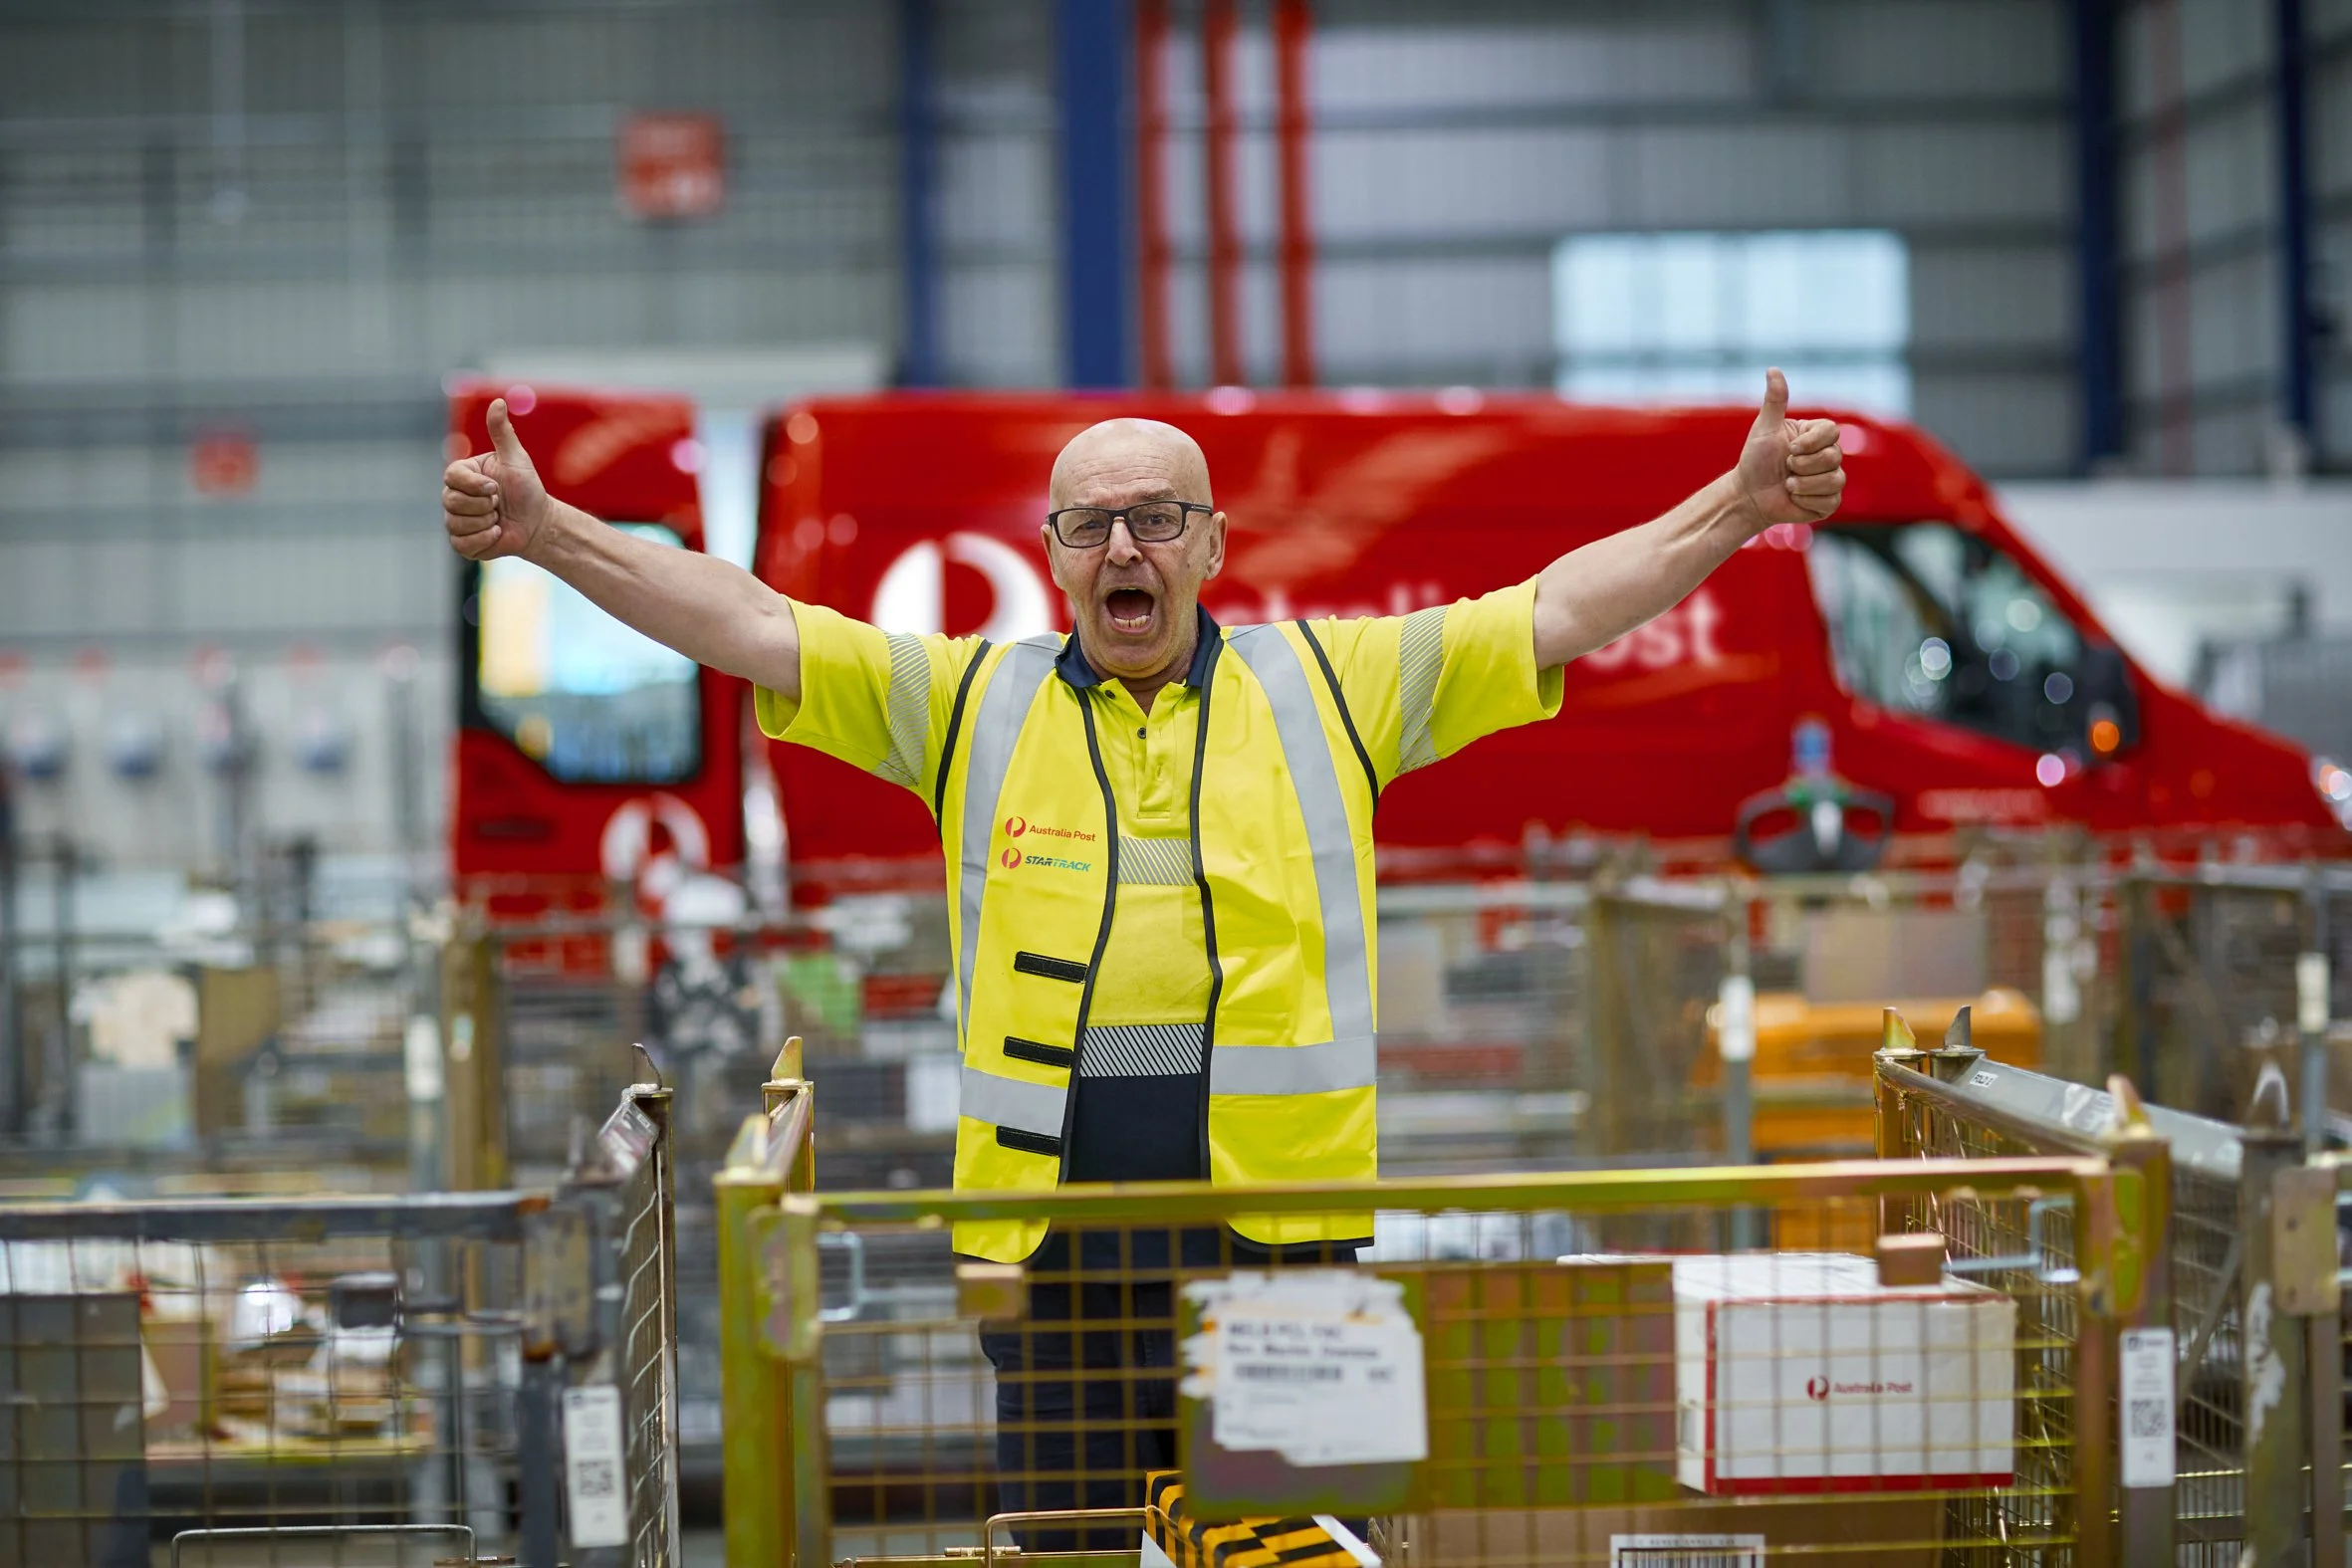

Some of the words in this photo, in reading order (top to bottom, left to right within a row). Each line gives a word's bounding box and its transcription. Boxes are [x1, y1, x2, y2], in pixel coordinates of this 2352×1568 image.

[1030, 825, 1071, 838] Australia
[1073, 830, 1095, 841] Post
[1026, 855, 1090, 871] STARTRACK
[1834, 1382, 1883, 1393] Australia
[1887, 1382, 1912, 1393] Post
